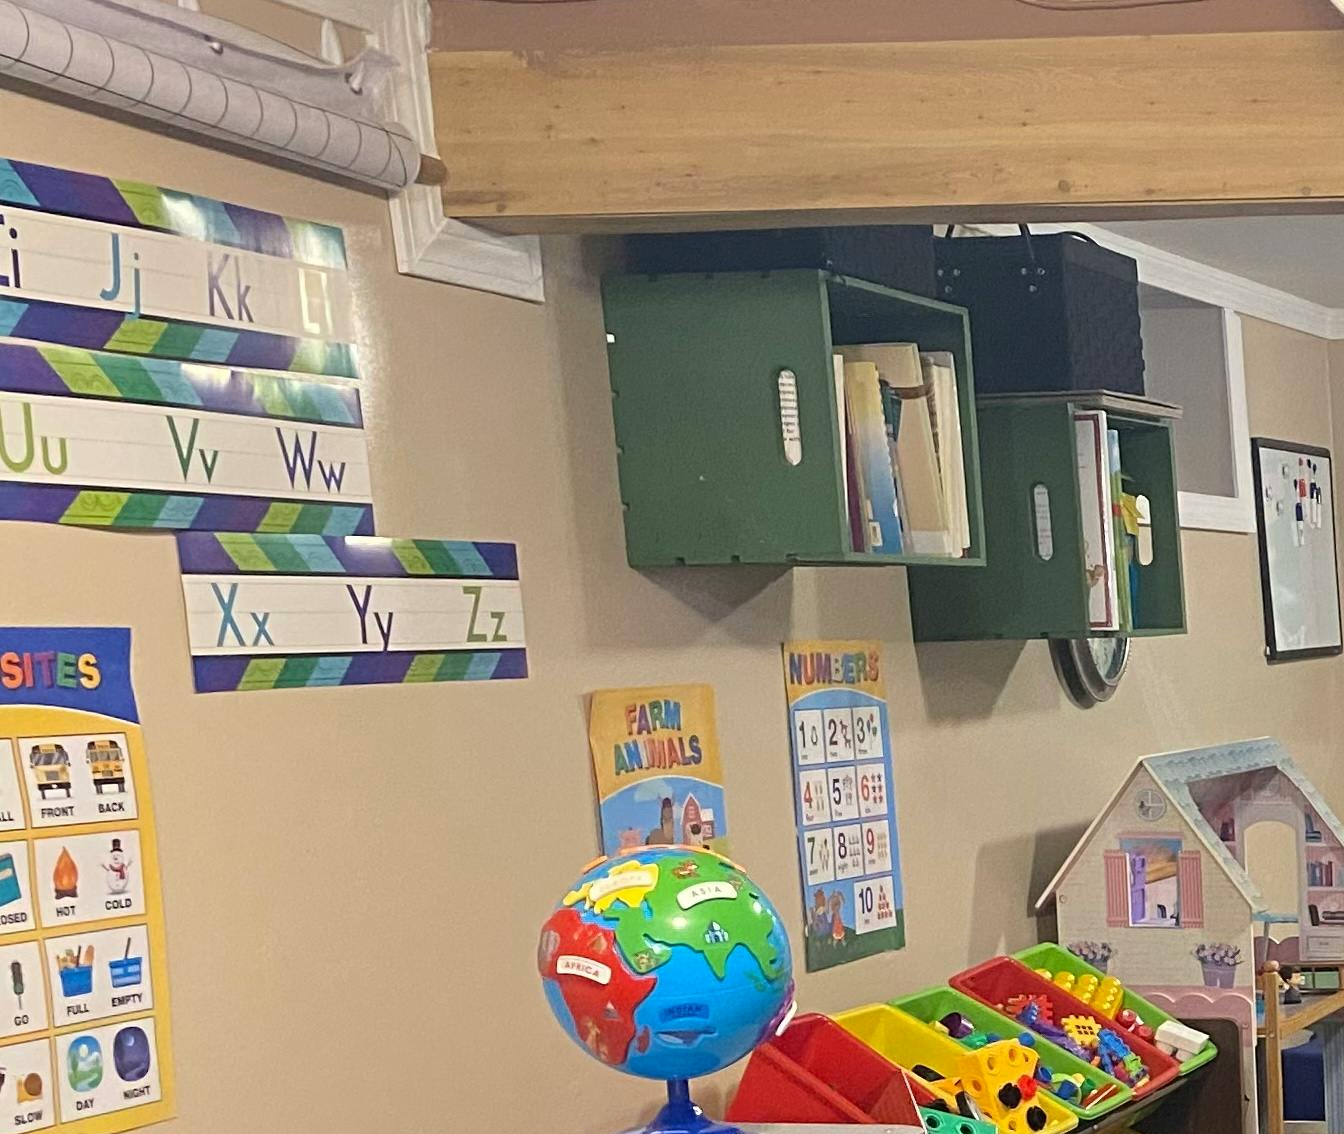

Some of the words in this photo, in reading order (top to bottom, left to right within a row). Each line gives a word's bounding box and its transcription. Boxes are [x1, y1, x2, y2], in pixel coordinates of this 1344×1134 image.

[100, 233, 141, 320] Jj
[207, 253, 254, 323] Kk
[0, 402, 68, 475] Uu
[166, 415, 219, 483] Vv
[276, 427, 346, 492] Ww
[211, 582, 275, 647] Xx
[346, 584, 393, 652] Yy
[462, 586, 508, 643] Zz
[789, 651, 880, 686] NUMBERS
[625, 699, 681, 736] FARM
[799, 720, 807, 748] 1
[828, 718, 839, 746] 2
[856, 717, 866, 744] 3
[614, 735, 702, 776] ANIMALS
[803, 781, 813, 809] 4
[832, 778, 842, 805] 5
[861, 775, 870, 801] 6
[41, 805, 75, 819] FRONT
[98, 801, 125, 815] BACK
[807, 837, 816, 865] 7
[838, 832, 847, 859] 8
[866, 828, 875, 854] 9
[56, 905, 76, 917] HOT
[105, 898, 132, 911] COLD
[690, 885, 723, 898] ASIA
[858, 886, 874, 914] 10
[563, 960, 601, 978] AFRICA
[14, 1014, 29, 1027] GO
[67, 1003, 90, 1016] FULL
[112, 992, 143, 1008] EMPTY
[14, 1110, 44, 1126] SLOW
[76, 1098, 95, 1112] DAY
[123, 1084, 152, 1100] NIGHT
